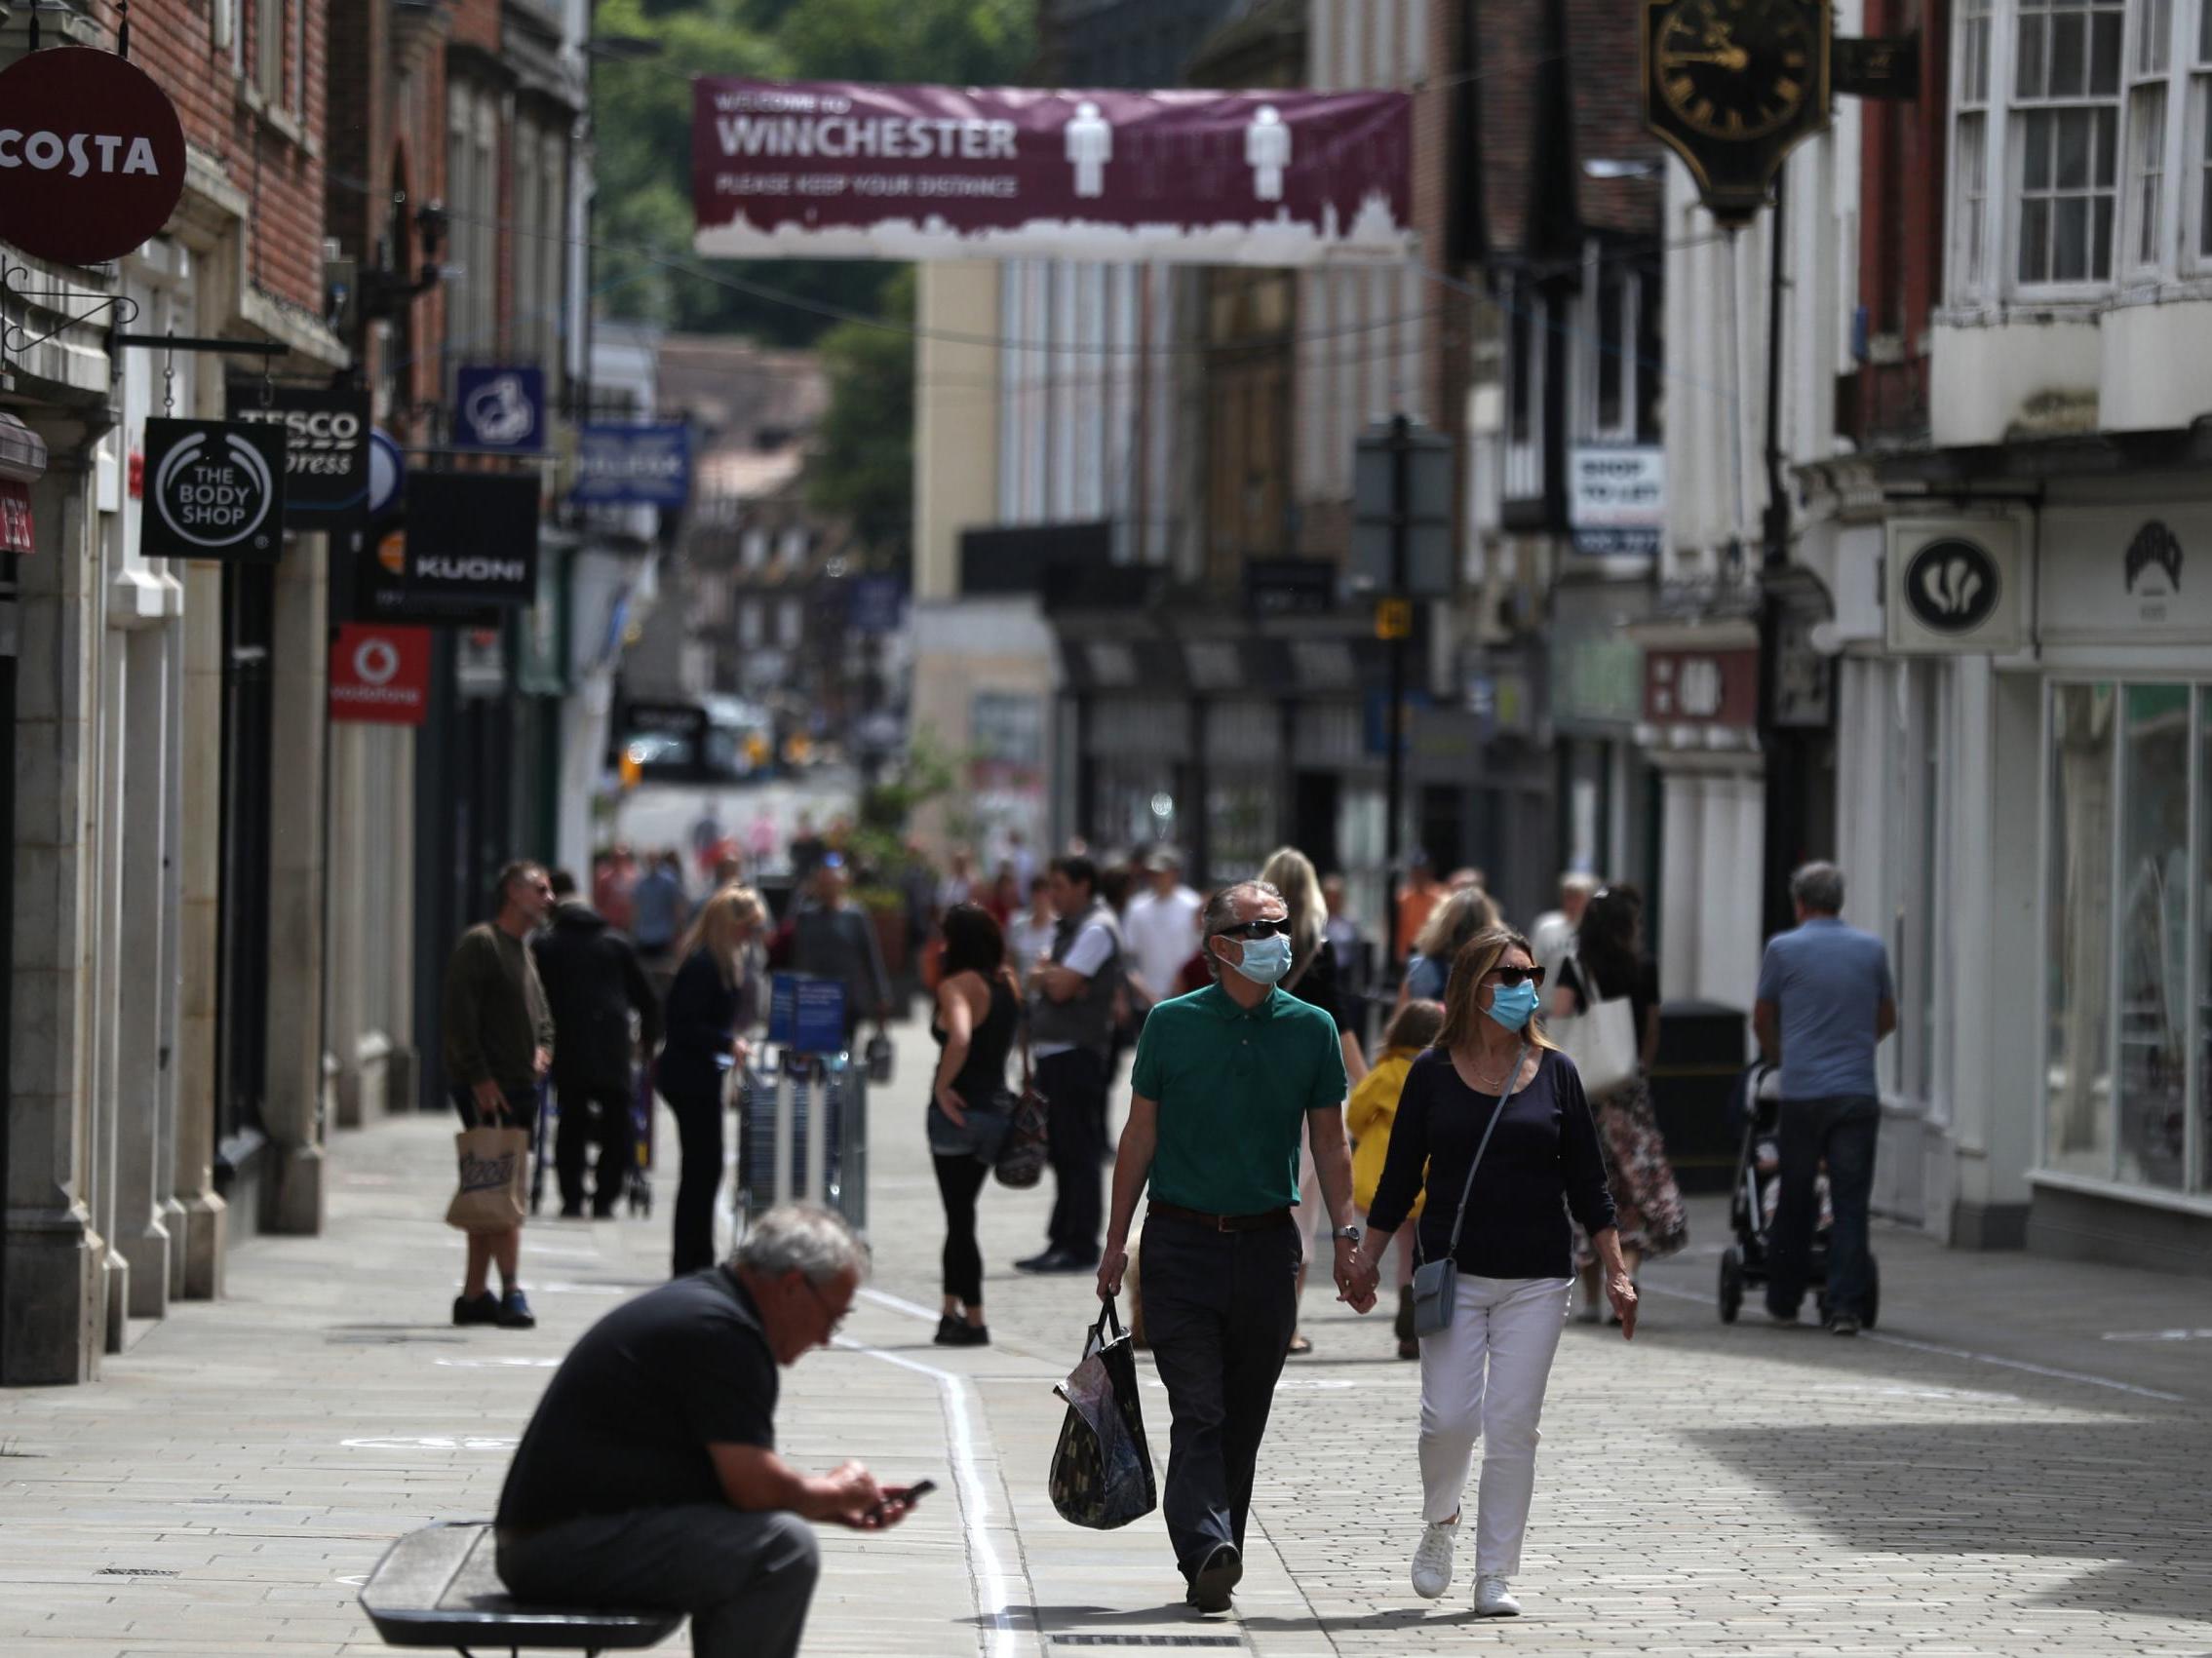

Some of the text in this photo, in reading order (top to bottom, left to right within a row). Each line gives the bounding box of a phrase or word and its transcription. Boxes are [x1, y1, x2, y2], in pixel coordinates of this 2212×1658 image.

[715, 92, 852, 114] WELCOME TO
[716, 116, 1018, 159] WINCHESTER
[0, 129, 160, 178] COSTA
[716, 174, 1018, 198] PLEASE KEEP YOUR DISTANCE
[285, 451, 353, 475] ress
[1581, 459, 1643, 478] SHOP
[195, 466, 234, 484] THE
[179, 484, 250, 506] BODY
[182, 504, 246, 525] SHOP
[415, 555, 525, 581] KUONI
